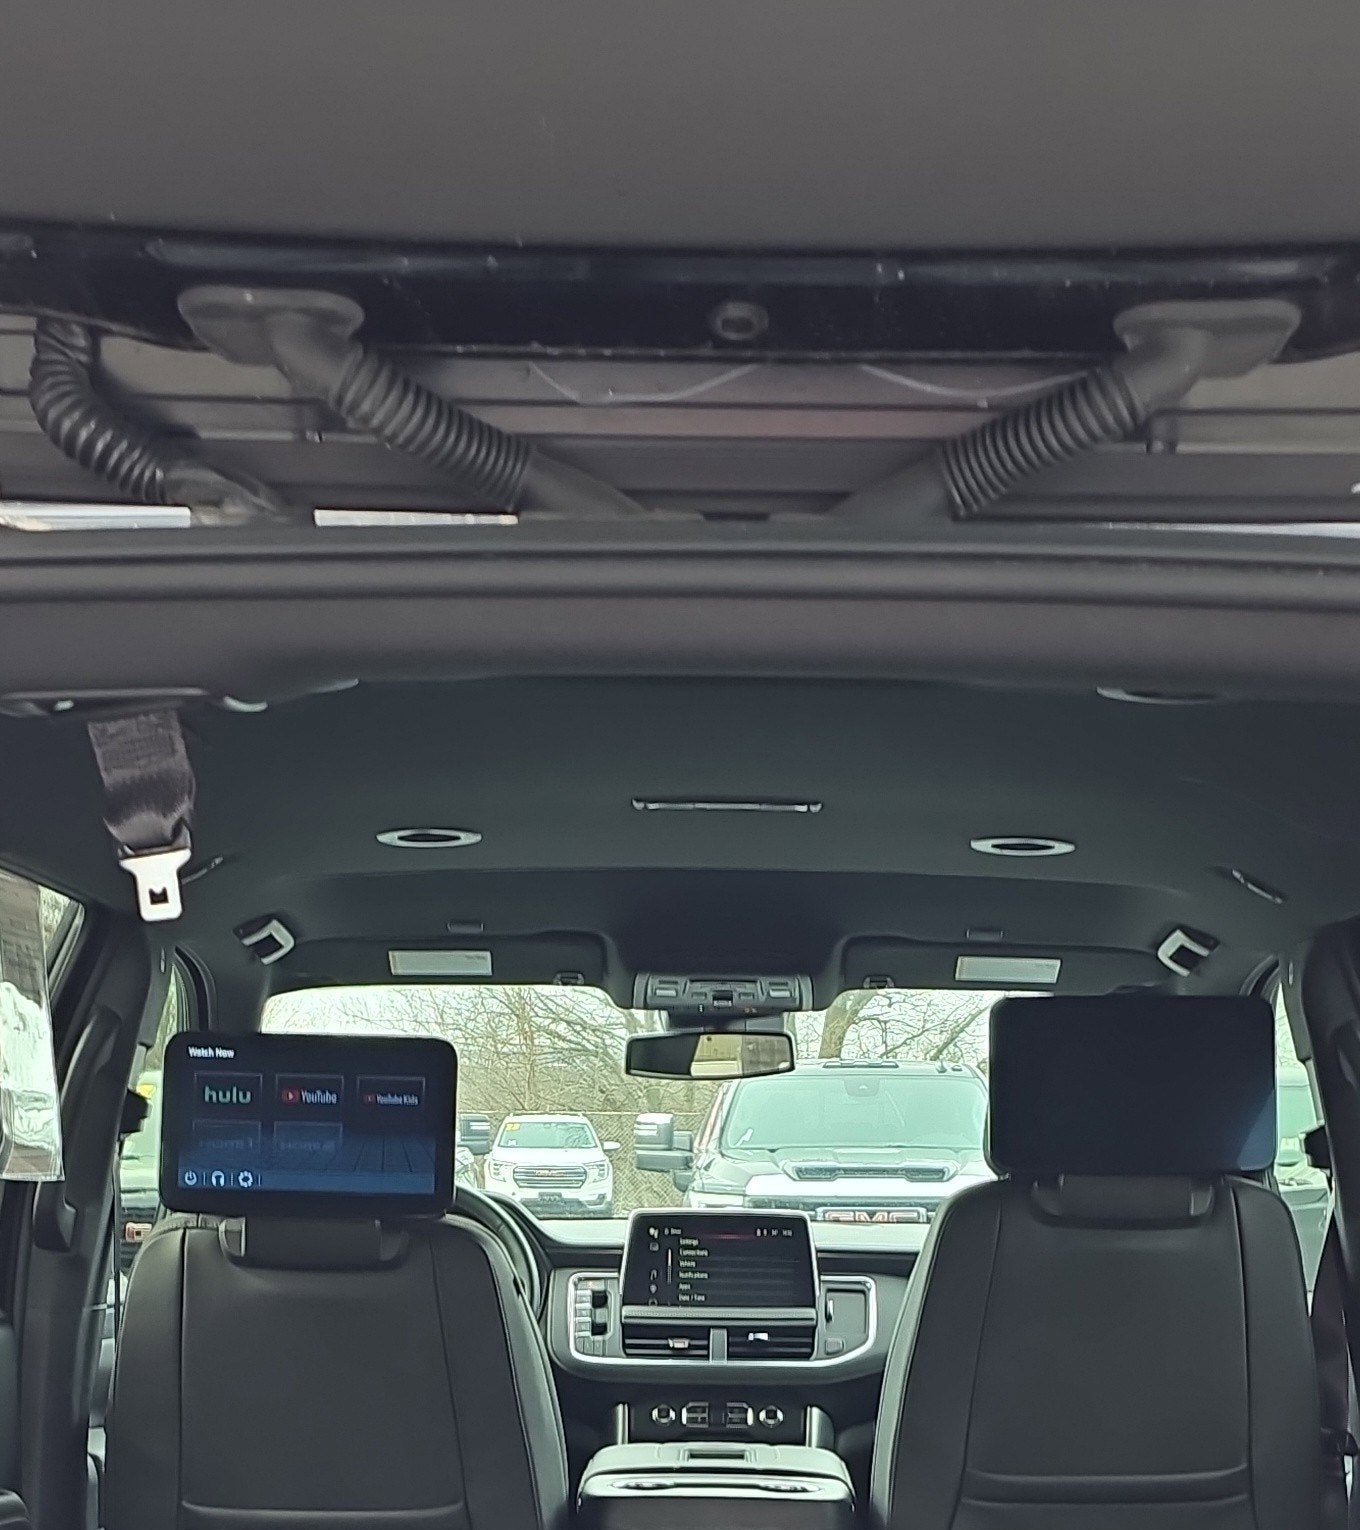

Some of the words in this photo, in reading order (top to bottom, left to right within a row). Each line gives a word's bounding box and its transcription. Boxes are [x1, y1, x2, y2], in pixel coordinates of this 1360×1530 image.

[188, 1046, 214, 1058] Watch
[215, 1047, 235, 1059] Now
[204, 1086, 251, 1104] hulu
[300, 1089, 337, 1104] YouTube
